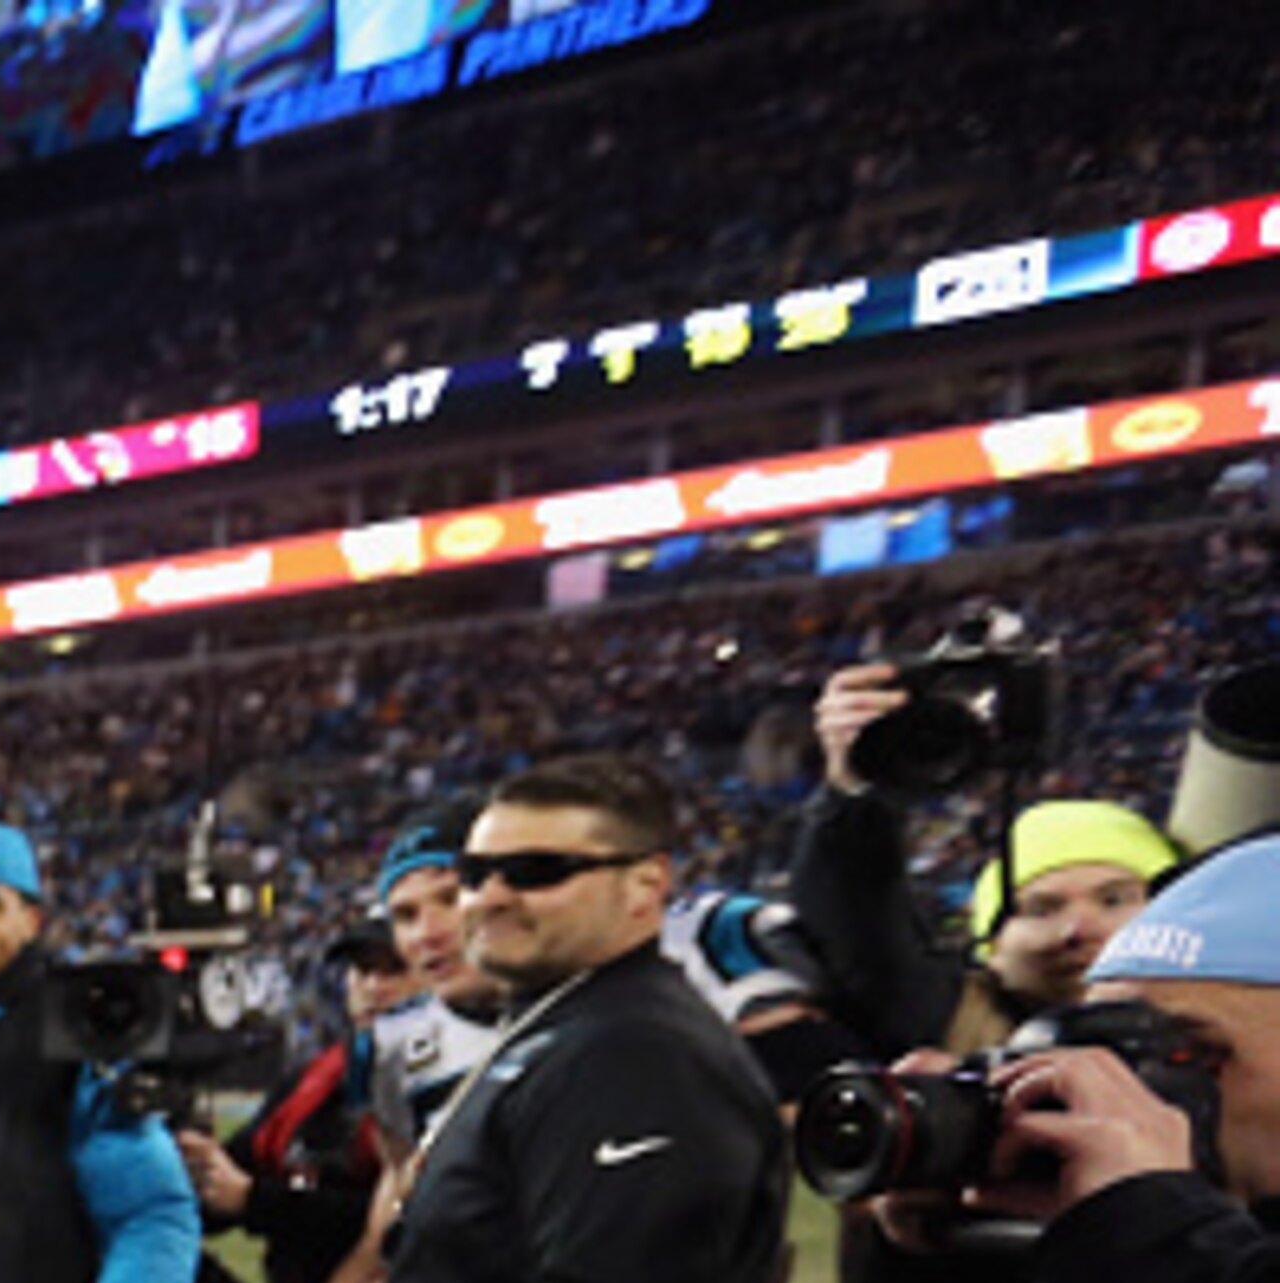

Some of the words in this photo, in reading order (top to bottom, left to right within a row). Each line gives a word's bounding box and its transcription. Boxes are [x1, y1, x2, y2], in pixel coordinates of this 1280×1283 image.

[236, 46, 446, 148] CAROLINA
[458, 0, 712, 87] PANTHERS
[329, 367, 451, 433] 1:17
